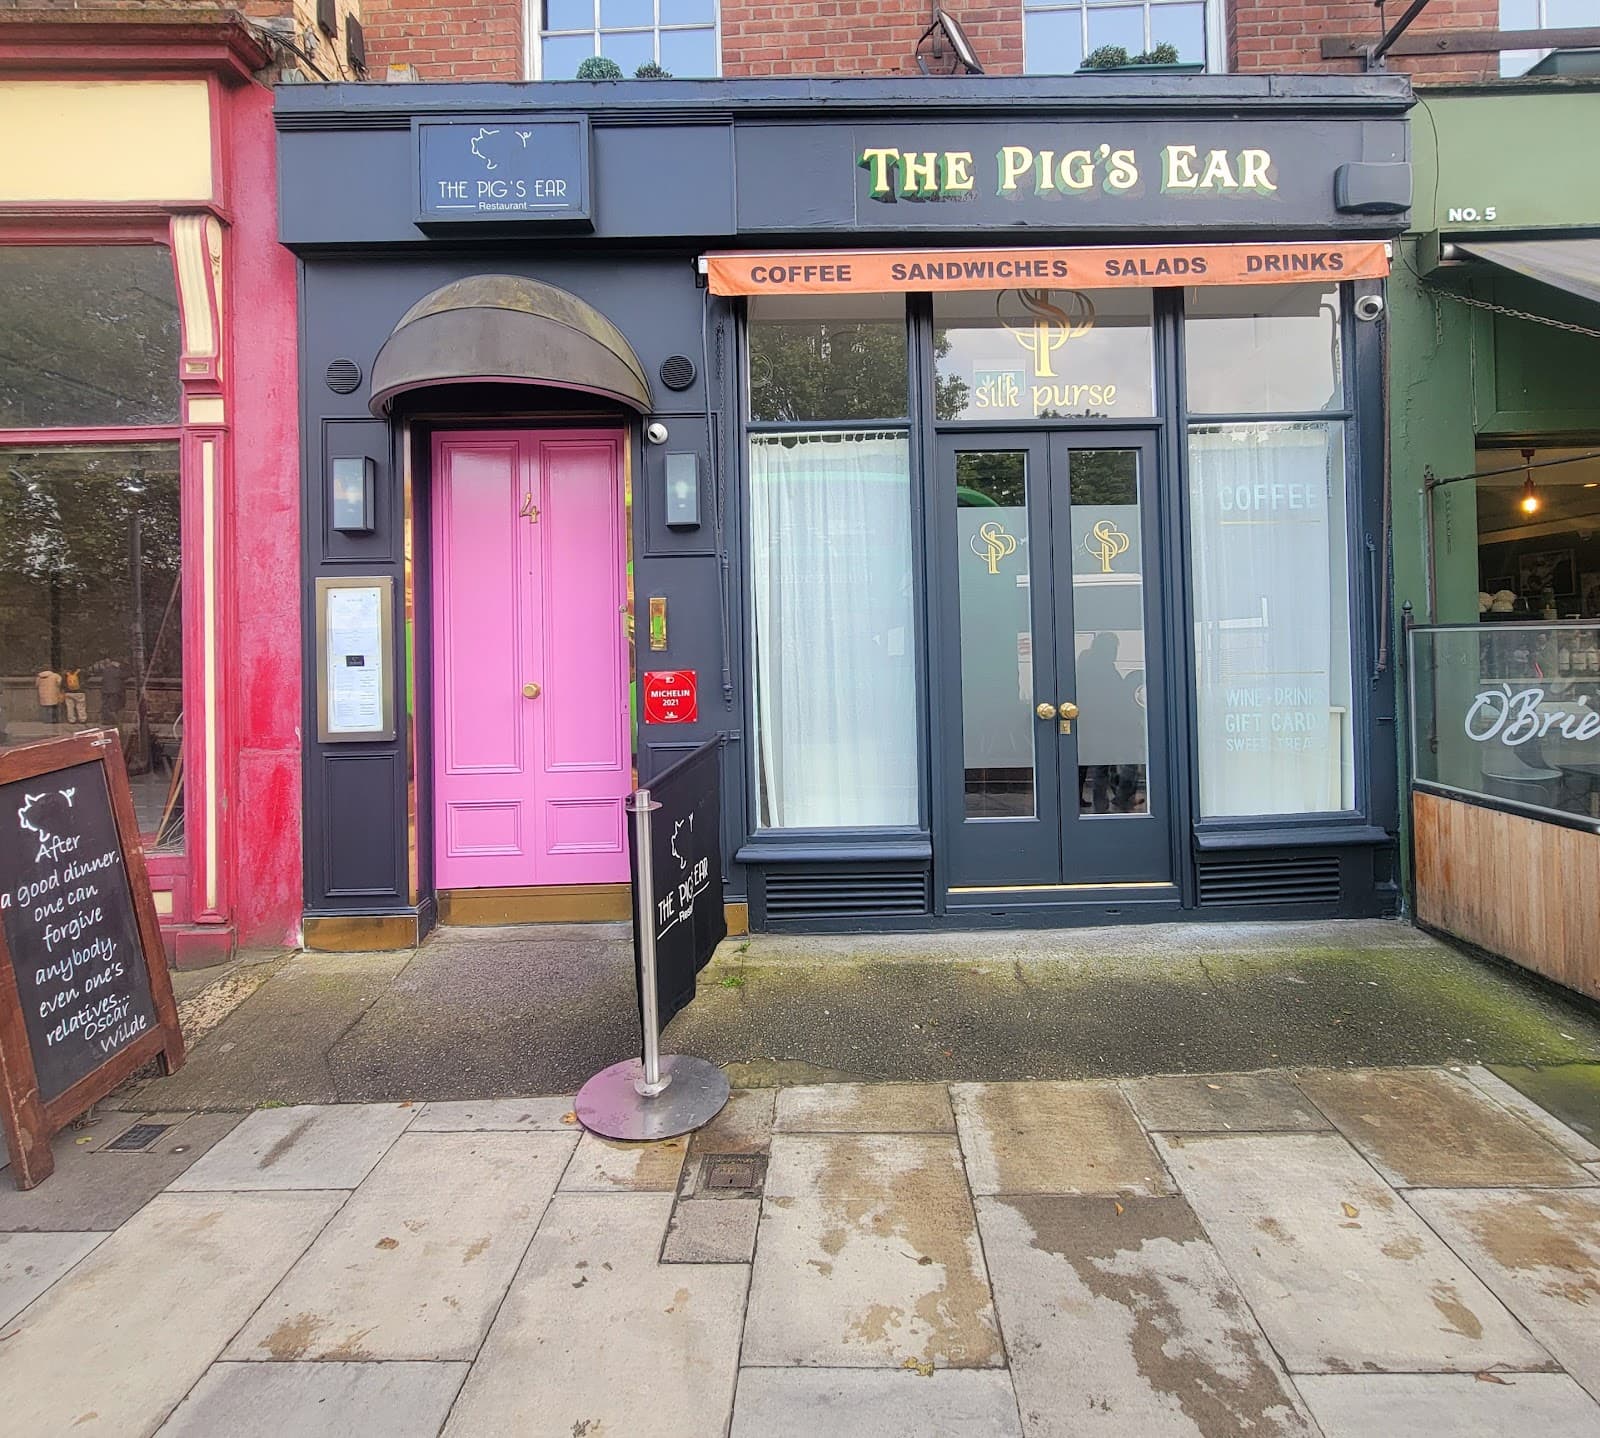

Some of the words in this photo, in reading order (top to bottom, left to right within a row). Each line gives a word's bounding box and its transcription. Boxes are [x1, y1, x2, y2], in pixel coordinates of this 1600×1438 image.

[438, 181, 468, 199] THE
[477, 180, 526, 198] PIG'S
[535, 179, 566, 197] EAR
[858, 147, 974, 201] THE
[998, 144, 1140, 193] PIG'S
[1162, 144, 1279, 193] EAR
[478, 201, 528, 211] Restaurant
[1448, 207, 1480, 221] NO.
[1485, 206, 1497, 220] 5
[751, 264, 851, 283] COFFEE
[892, 259, 1068, 280] SANDWICHES
[1105, 256, 1207, 277] SALADS
[1246, 252, 1344, 273] DRINKS
[975, 375, 1021, 408] silk
[1031, 383, 1117, 416] purse
[519, 492, 541, 524] 4
[1220, 483, 1317, 511] COFFEE
[650, 689, 690, 698] MICHELIN
[662, 698, 679, 707] 2021
[1225, 712, 1262, 732] GIFT
[35, 833, 81, 863] After
[0, 893, 12, 909] a
[17, 872, 60, 907] good
[64, 851, 120, 880] dinner,
[658, 890, 675, 926] THE
[694, 856, 710, 887] EAR
[34, 897, 65, 922] one
[67, 885, 99, 905] can
[42, 907, 104, 953] forgive
[35, 937, 118, 985] anybody,
[39, 988, 80, 1018] even
[85, 962, 125, 993] one's
[84, 1001, 131, 1041] Oscar
[100, 1014, 148, 1053] Wilde
